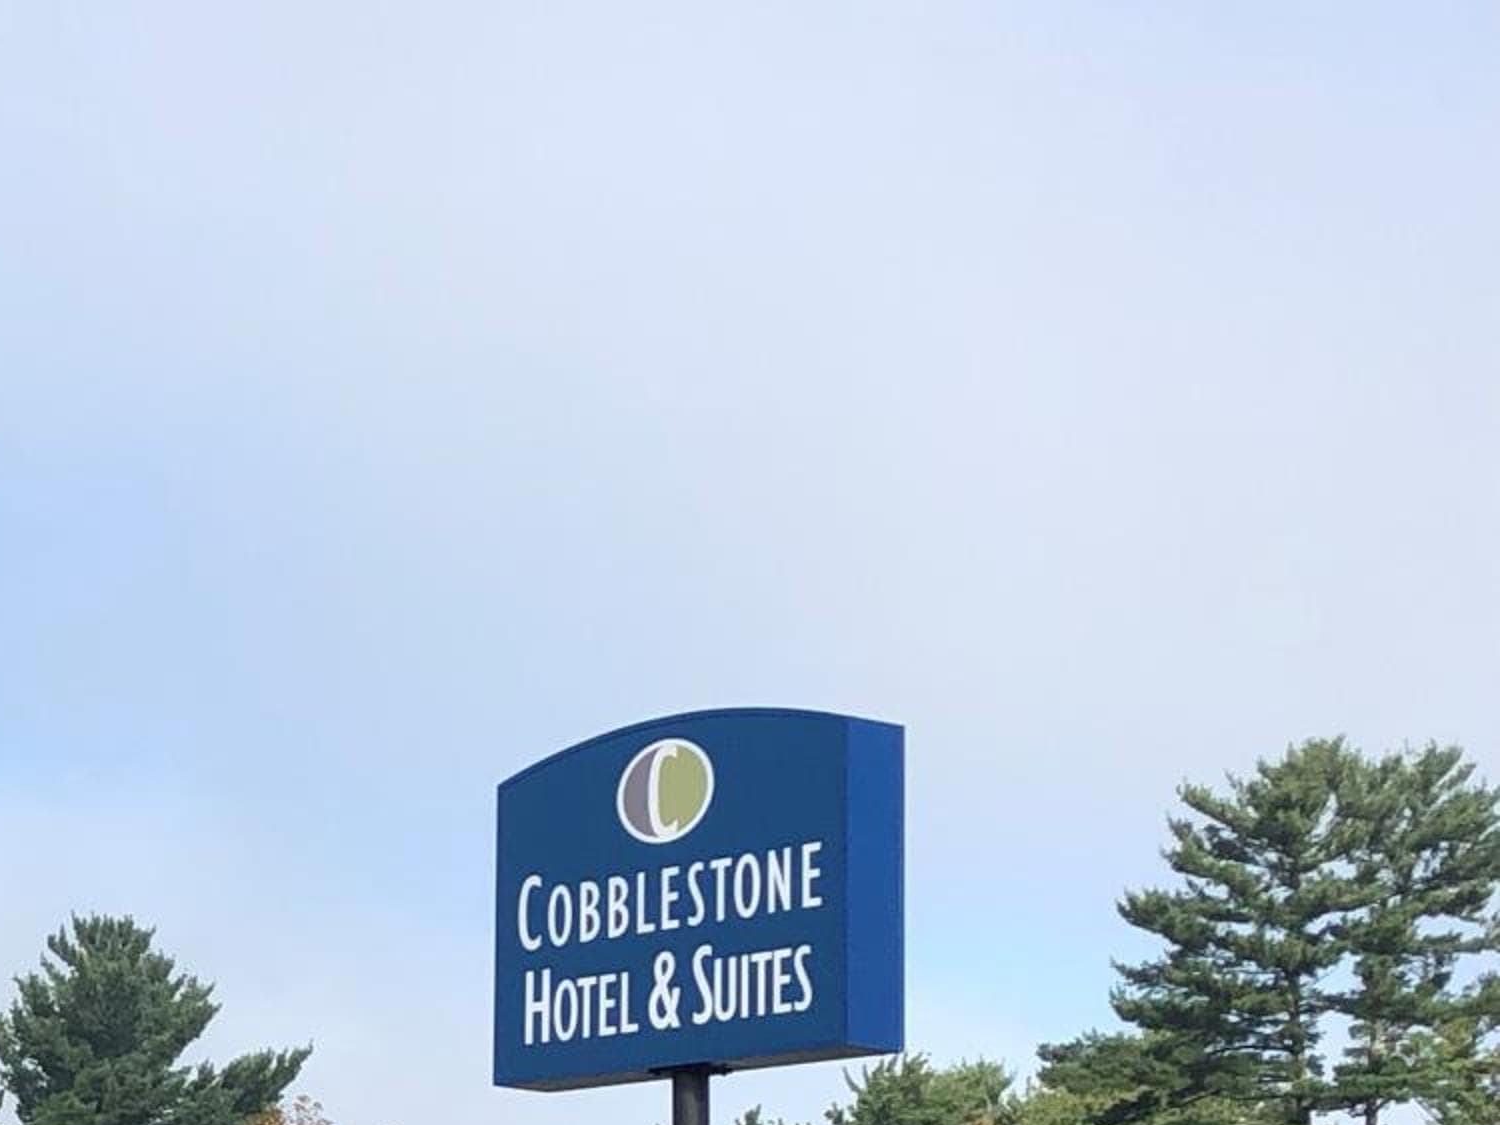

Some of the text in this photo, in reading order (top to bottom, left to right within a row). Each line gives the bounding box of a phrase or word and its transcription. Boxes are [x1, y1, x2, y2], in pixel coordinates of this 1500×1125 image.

[518, 841, 822, 951] COBBLESTONE
[525, 944, 813, 1045] HOTEL & SUITES
